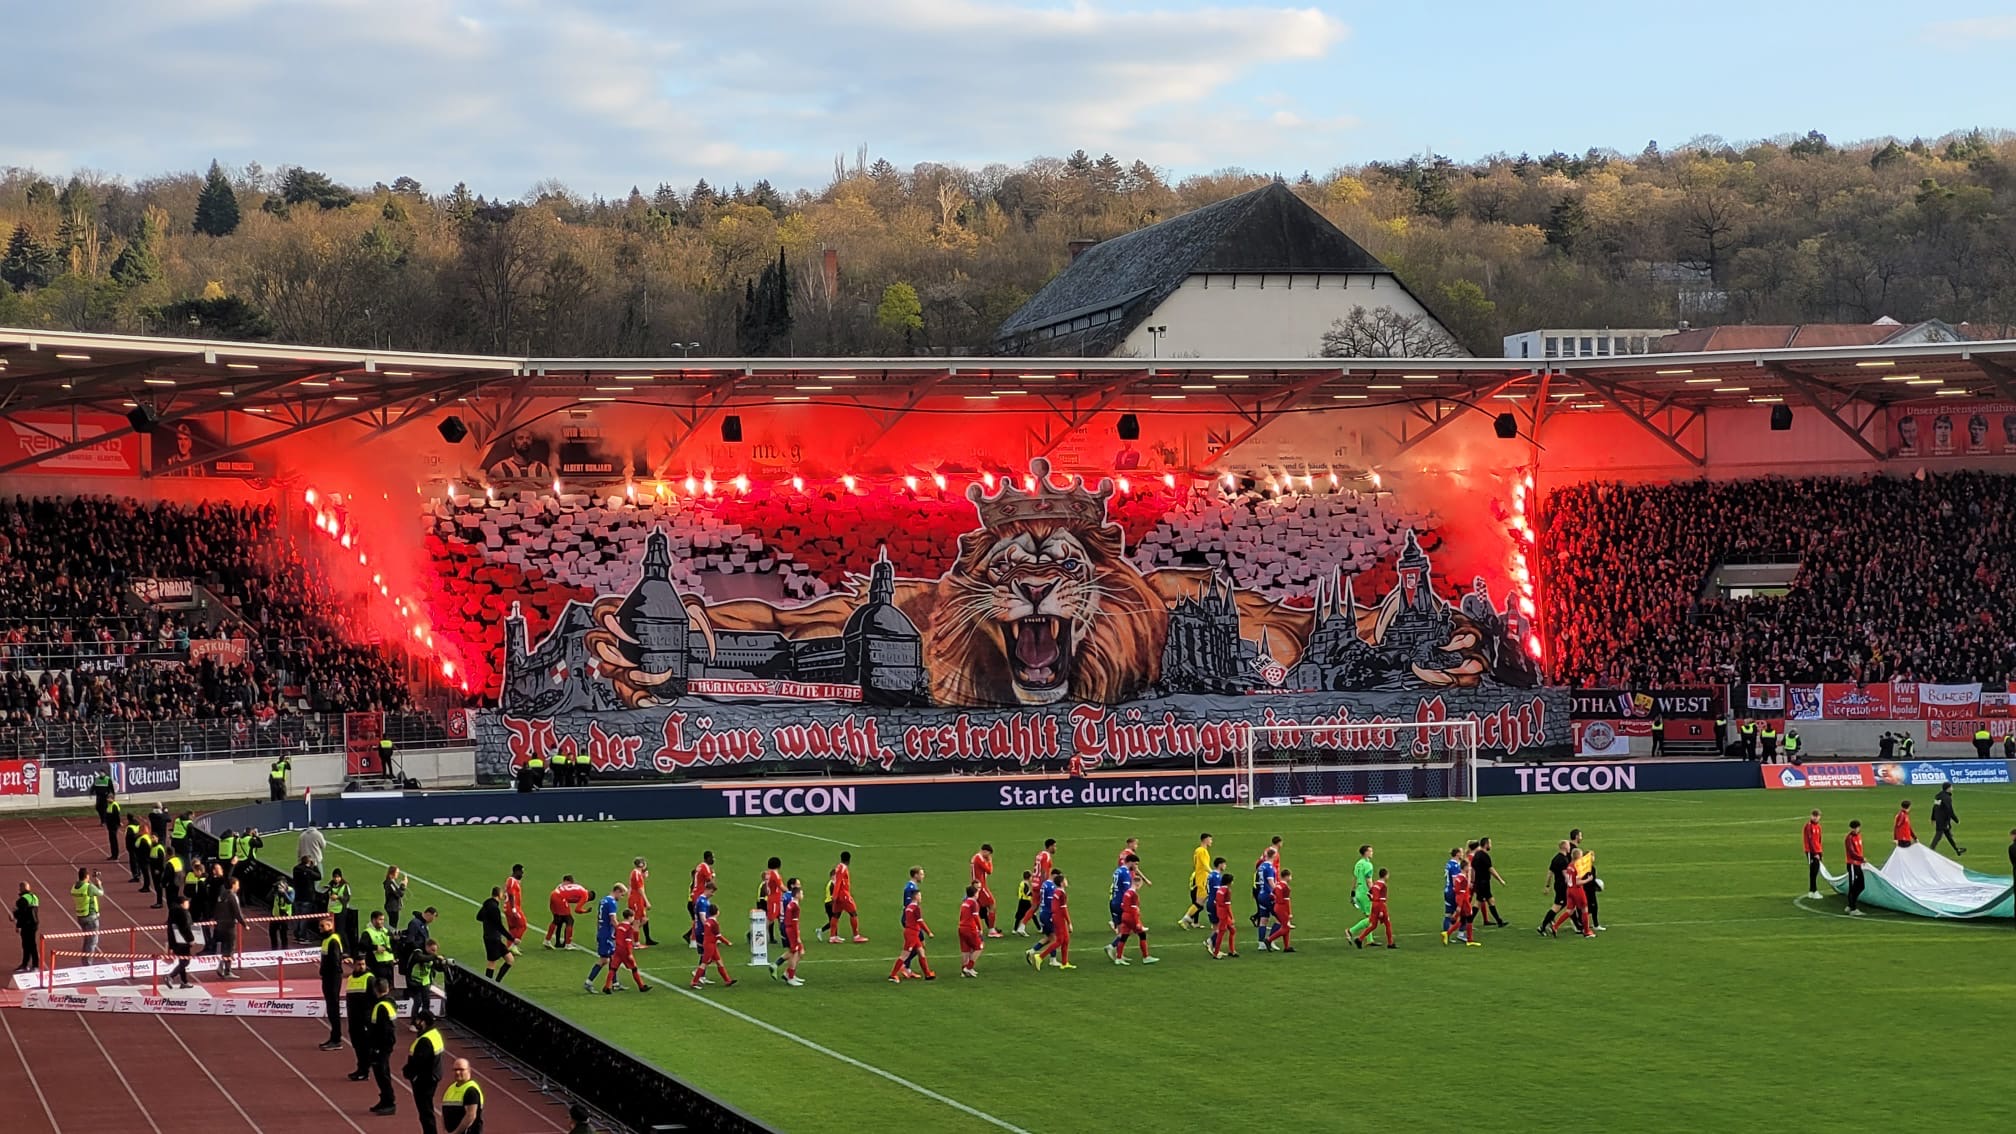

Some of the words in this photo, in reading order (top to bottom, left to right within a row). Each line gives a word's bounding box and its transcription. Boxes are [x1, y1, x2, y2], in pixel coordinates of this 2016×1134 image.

[1907, 406, 1939, 415] Unsere
[192, 640, 242, 658] OSTKURVE
[688, 680, 766, 693] THÜRINGENS
[781, 682, 819, 698] ECHTE
[823, 686, 861, 699] LIEBE
[1894, 683, 1915, 694] RWE
[1569, 697, 1618, 713] OTHA
[1658, 696, 1711, 713] WEST
[588, 719, 643, 772] der
[652, 710, 766, 774] Löwe
[771, 713, 896, 771] wacht,
[903, 711, 1062, 766] erstrahlt
[1067, 703, 1258, 769] Thüringen
[1263, 706, 1304, 750] in
[1310, 705, 1402, 750] seiner
[1410, 695, 1546, 760] Pracht!
[1944, 720, 1981, 737] SEKTO
[0, 772, 21, 787] en
[56, 770, 99, 793] Briga
[128, 766, 179, 786] Weimar
[1515, 765, 1636, 792] TECCON
[1950, 769, 1963, 777] Der
[722, 786, 856, 816] TECCON
[1000, 785, 1073, 806] Starte
[48, 994, 88, 1004] NextPhones
[144, 997, 187, 1008] NextPhones
[247, 1000, 294, 1010] NextPhones
